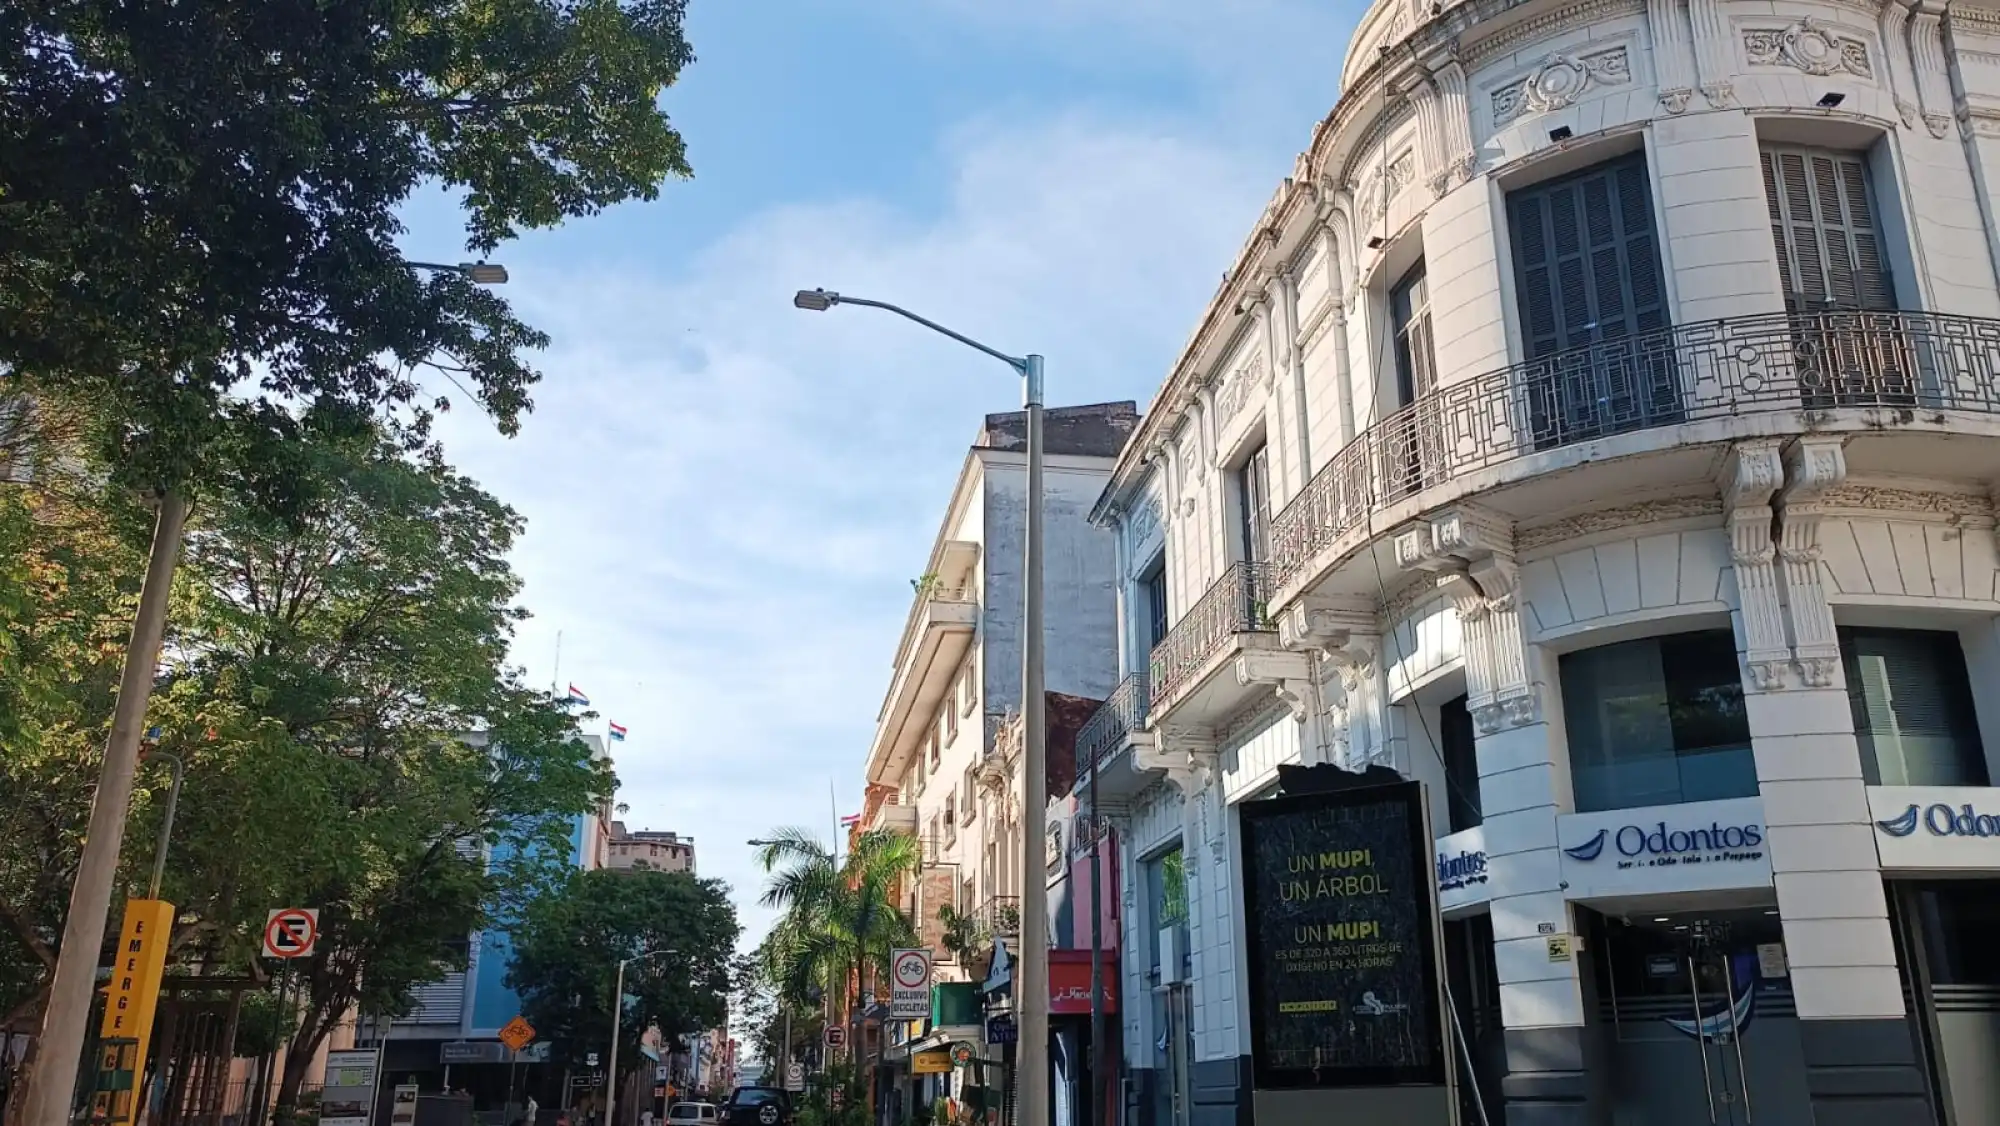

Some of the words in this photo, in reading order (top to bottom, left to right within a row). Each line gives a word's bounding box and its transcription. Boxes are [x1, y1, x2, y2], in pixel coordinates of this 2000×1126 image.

[1616, 822, 1762, 857] Odontos
[1288, 853, 1315, 873] UN
[1280, 880, 1310, 902] UN
[1316, 873, 1389, 898] ÁRBOL
[1294, 925, 1321, 944] UN
[1327, 920, 1379, 941] MUPI
[1275, 950, 1287, 960] ES
[1289, 949, 1302, 960] DE
[1323, 947, 1331, 957] A
[1352, 943, 1387, 956] LITROS
[1389, 941, 1402, 953] DE
[1329, 959, 1343, 971] EN
[1346, 957, 1357, 969] 24
[1358, 956, 1393, 968] HORAS
[894, 990, 927, 1000] EXCLUSIVO
[893, 1002, 929, 1012] BICICLETAS
[829, 1029, 841, 1044] E
